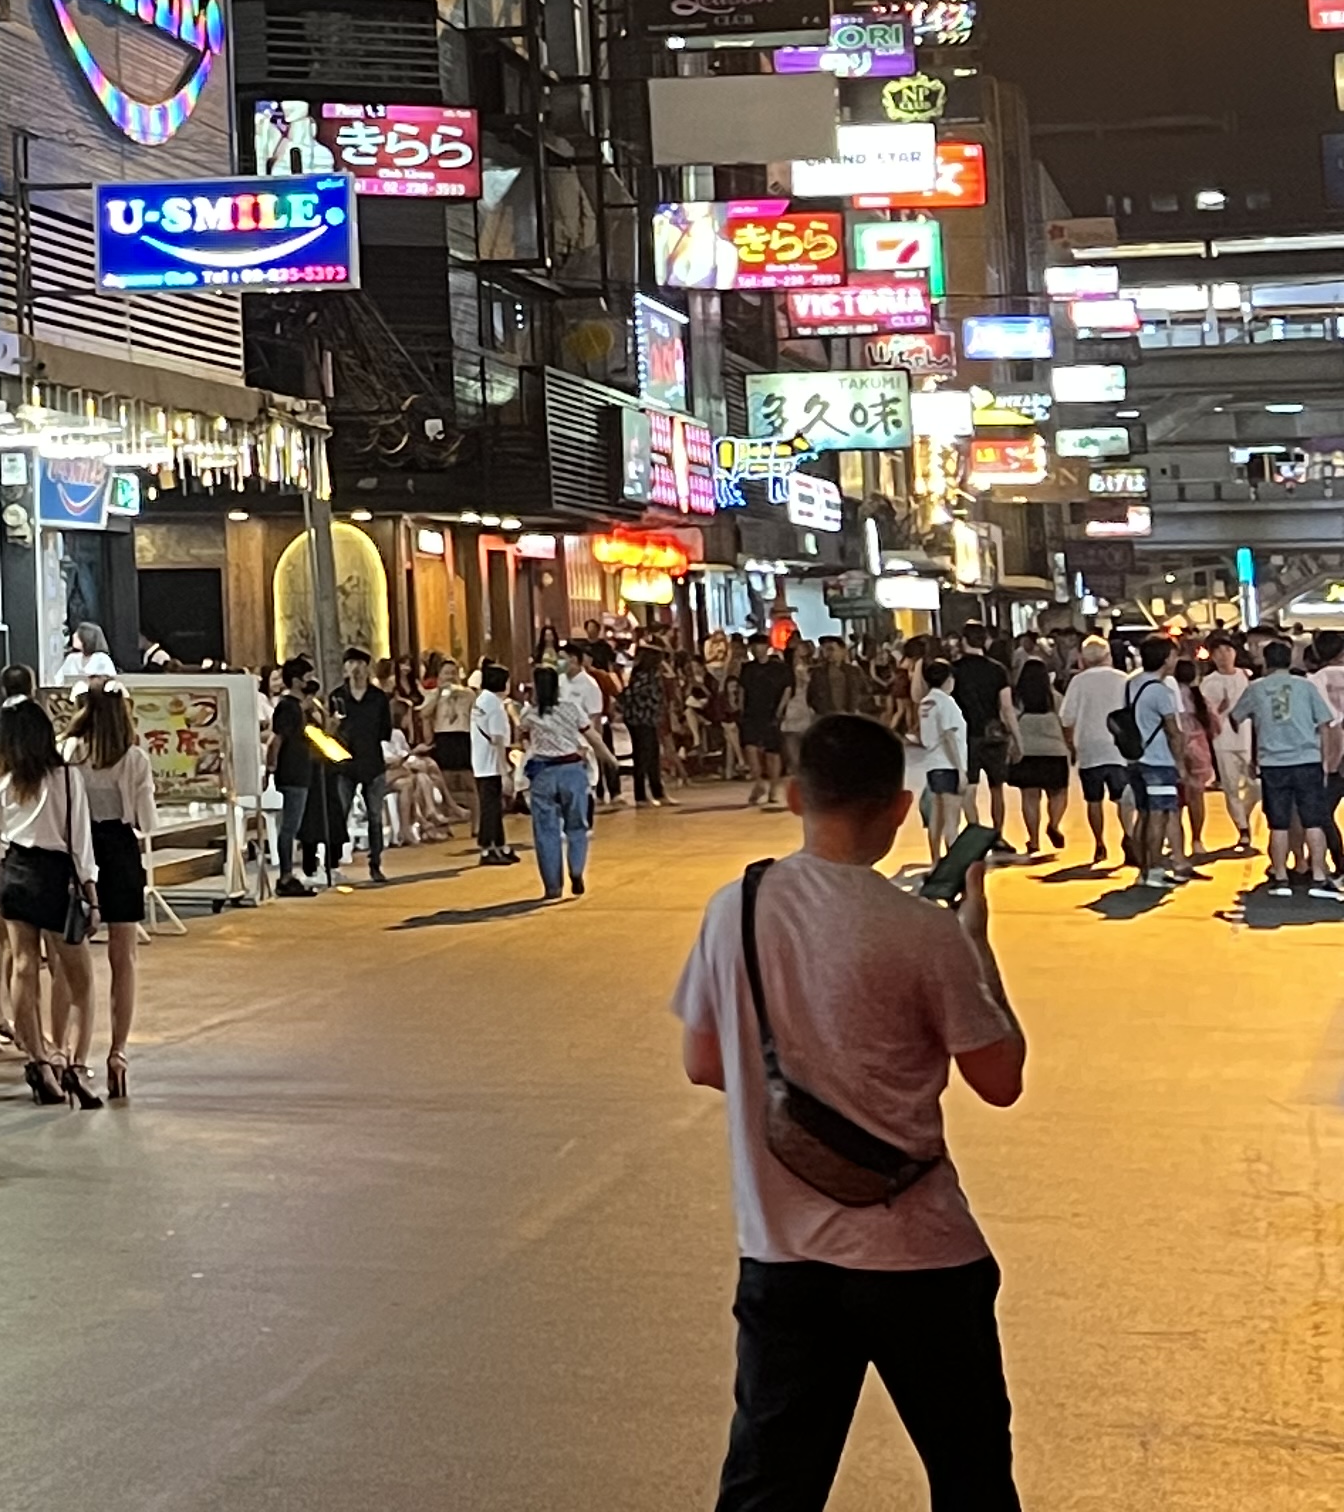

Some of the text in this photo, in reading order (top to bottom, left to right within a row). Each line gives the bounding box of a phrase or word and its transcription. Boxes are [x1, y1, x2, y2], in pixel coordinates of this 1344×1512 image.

[714, 14, 754, 26] CLUB
[336, 120, 474, 169] きらら
[733, 221, 838, 263] きらら
[792, 287, 927, 317] VICTORIA
[838, 375, 903, 390] TAKUMI
[762, 391, 904, 437] 多久味
